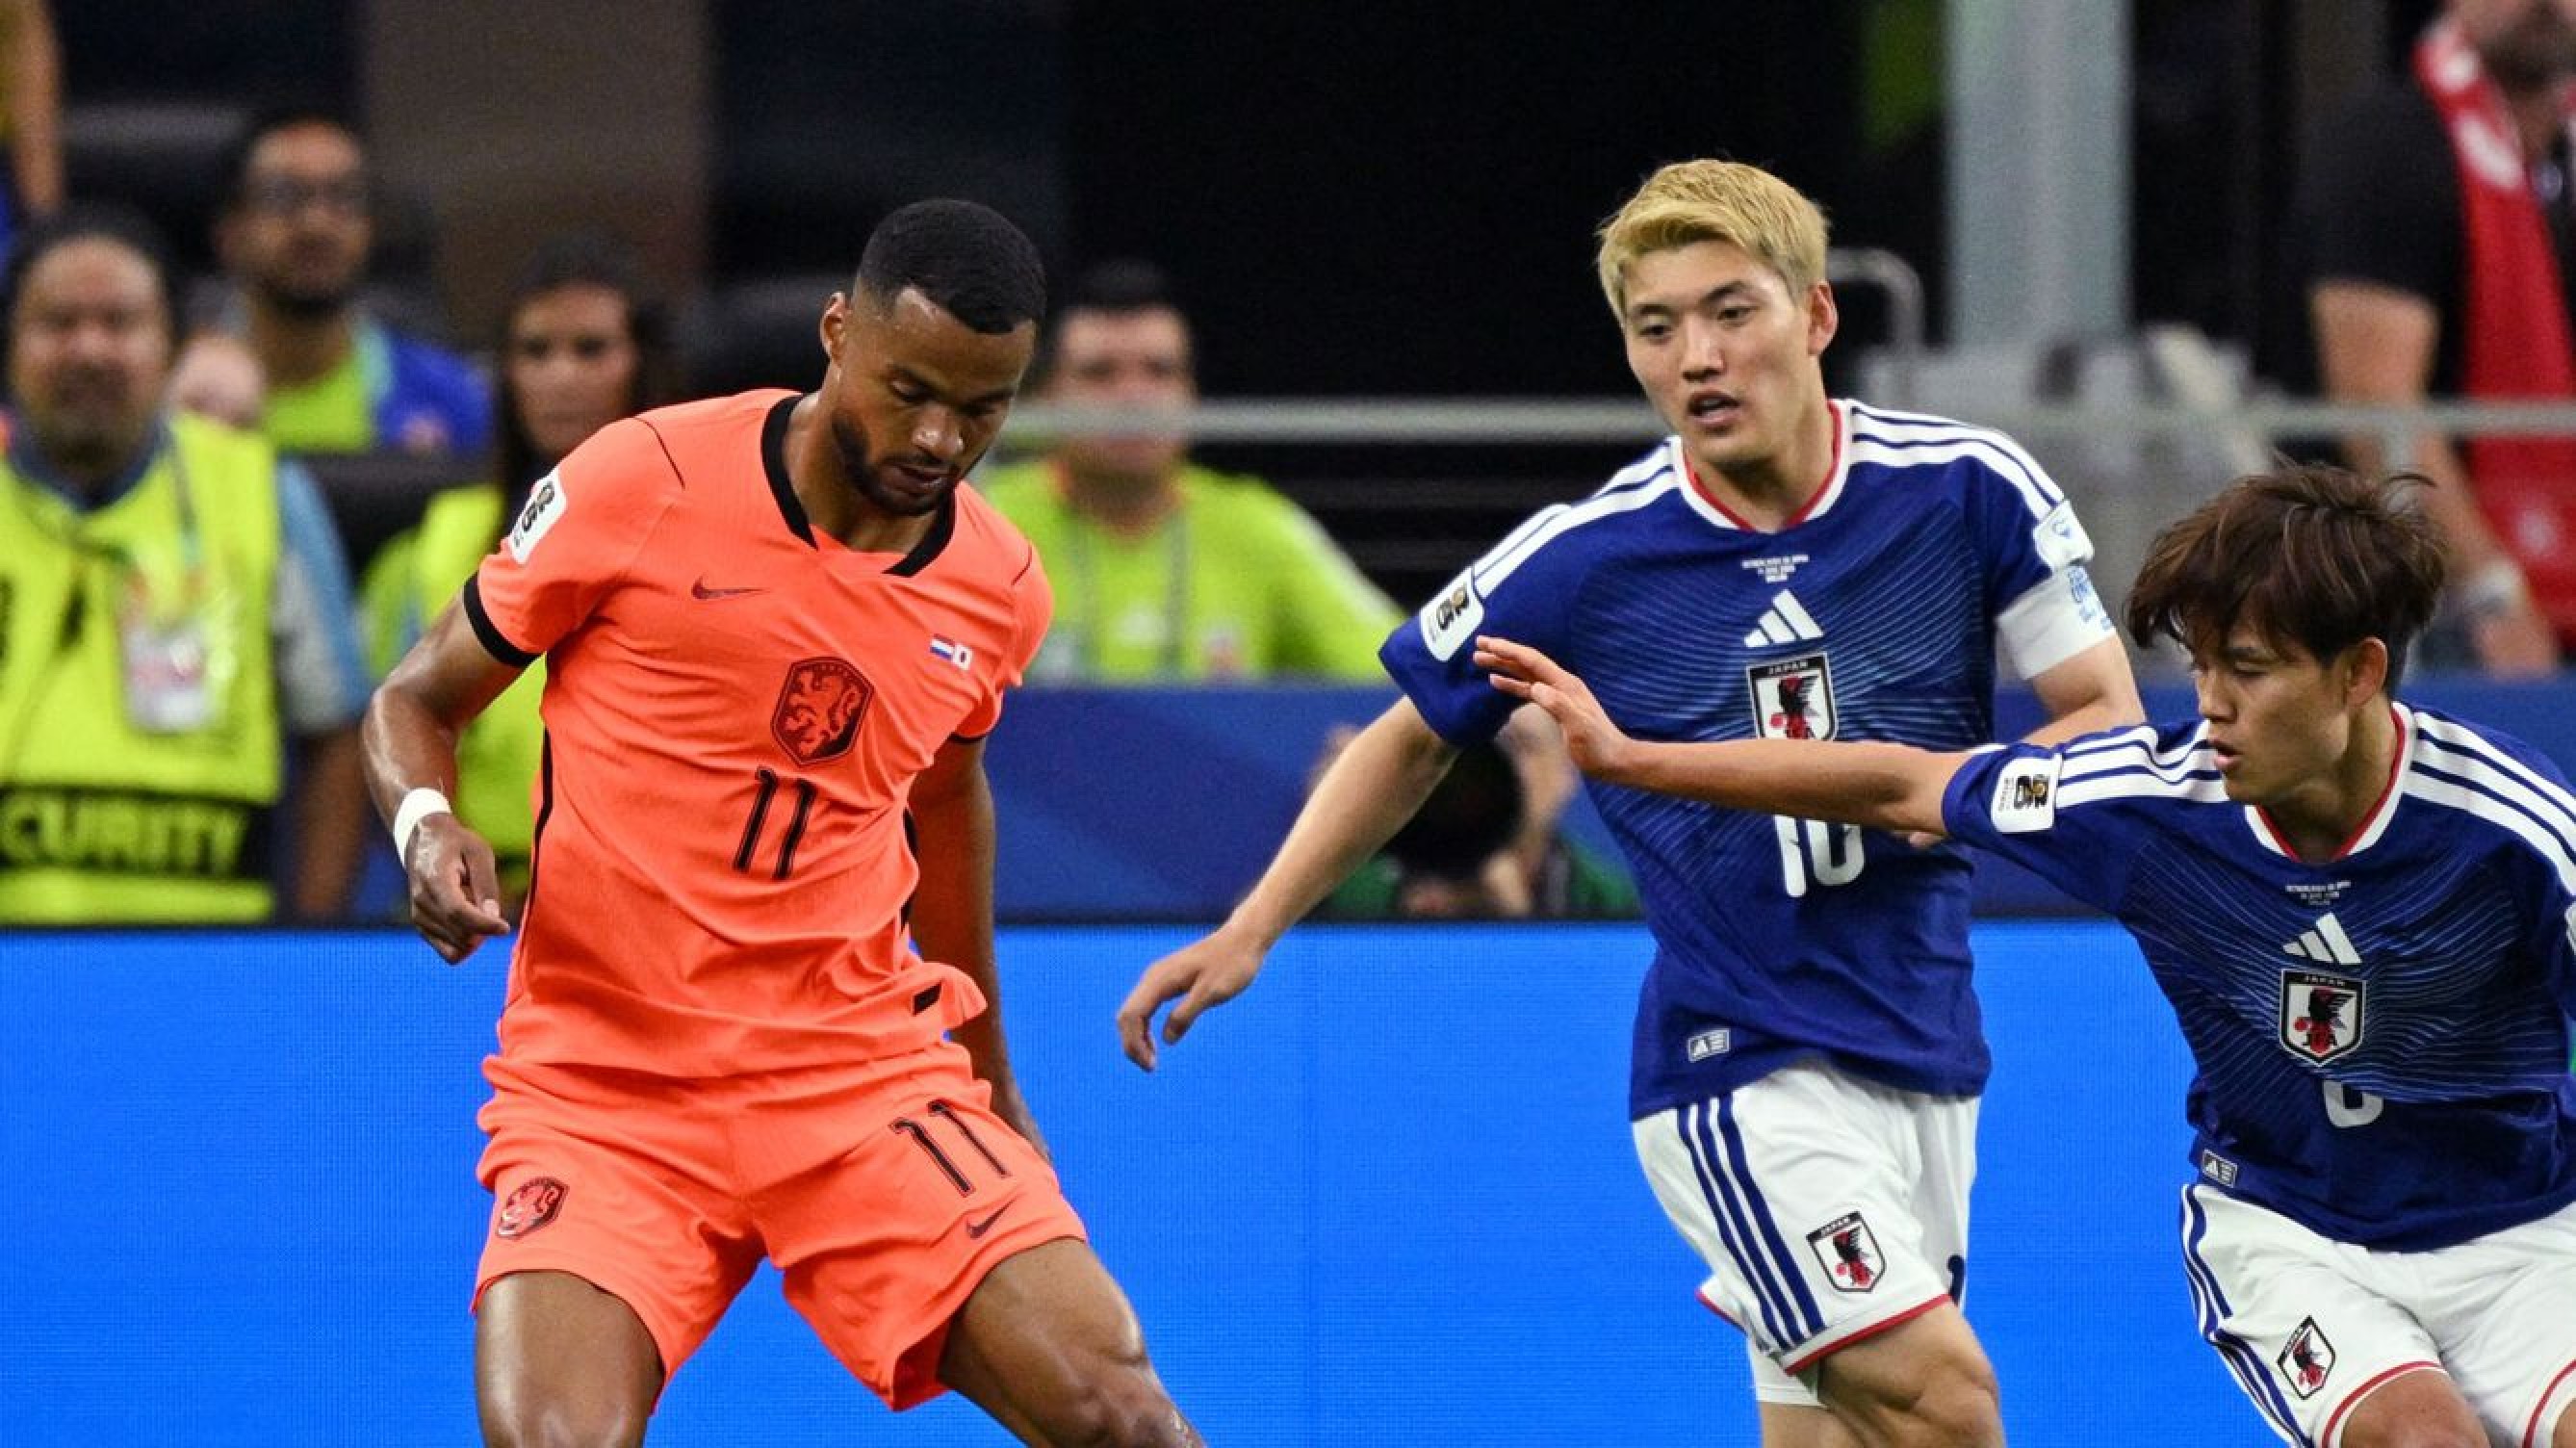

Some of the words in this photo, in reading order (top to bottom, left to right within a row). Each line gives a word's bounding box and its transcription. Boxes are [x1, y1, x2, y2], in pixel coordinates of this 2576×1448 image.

[1767, 660, 1809, 675] JAPAN
[734, 766, 817, 882] 11
[2305, 974, 2346, 987] JAPAN
[889, 1097, 1013, 1198] 11
